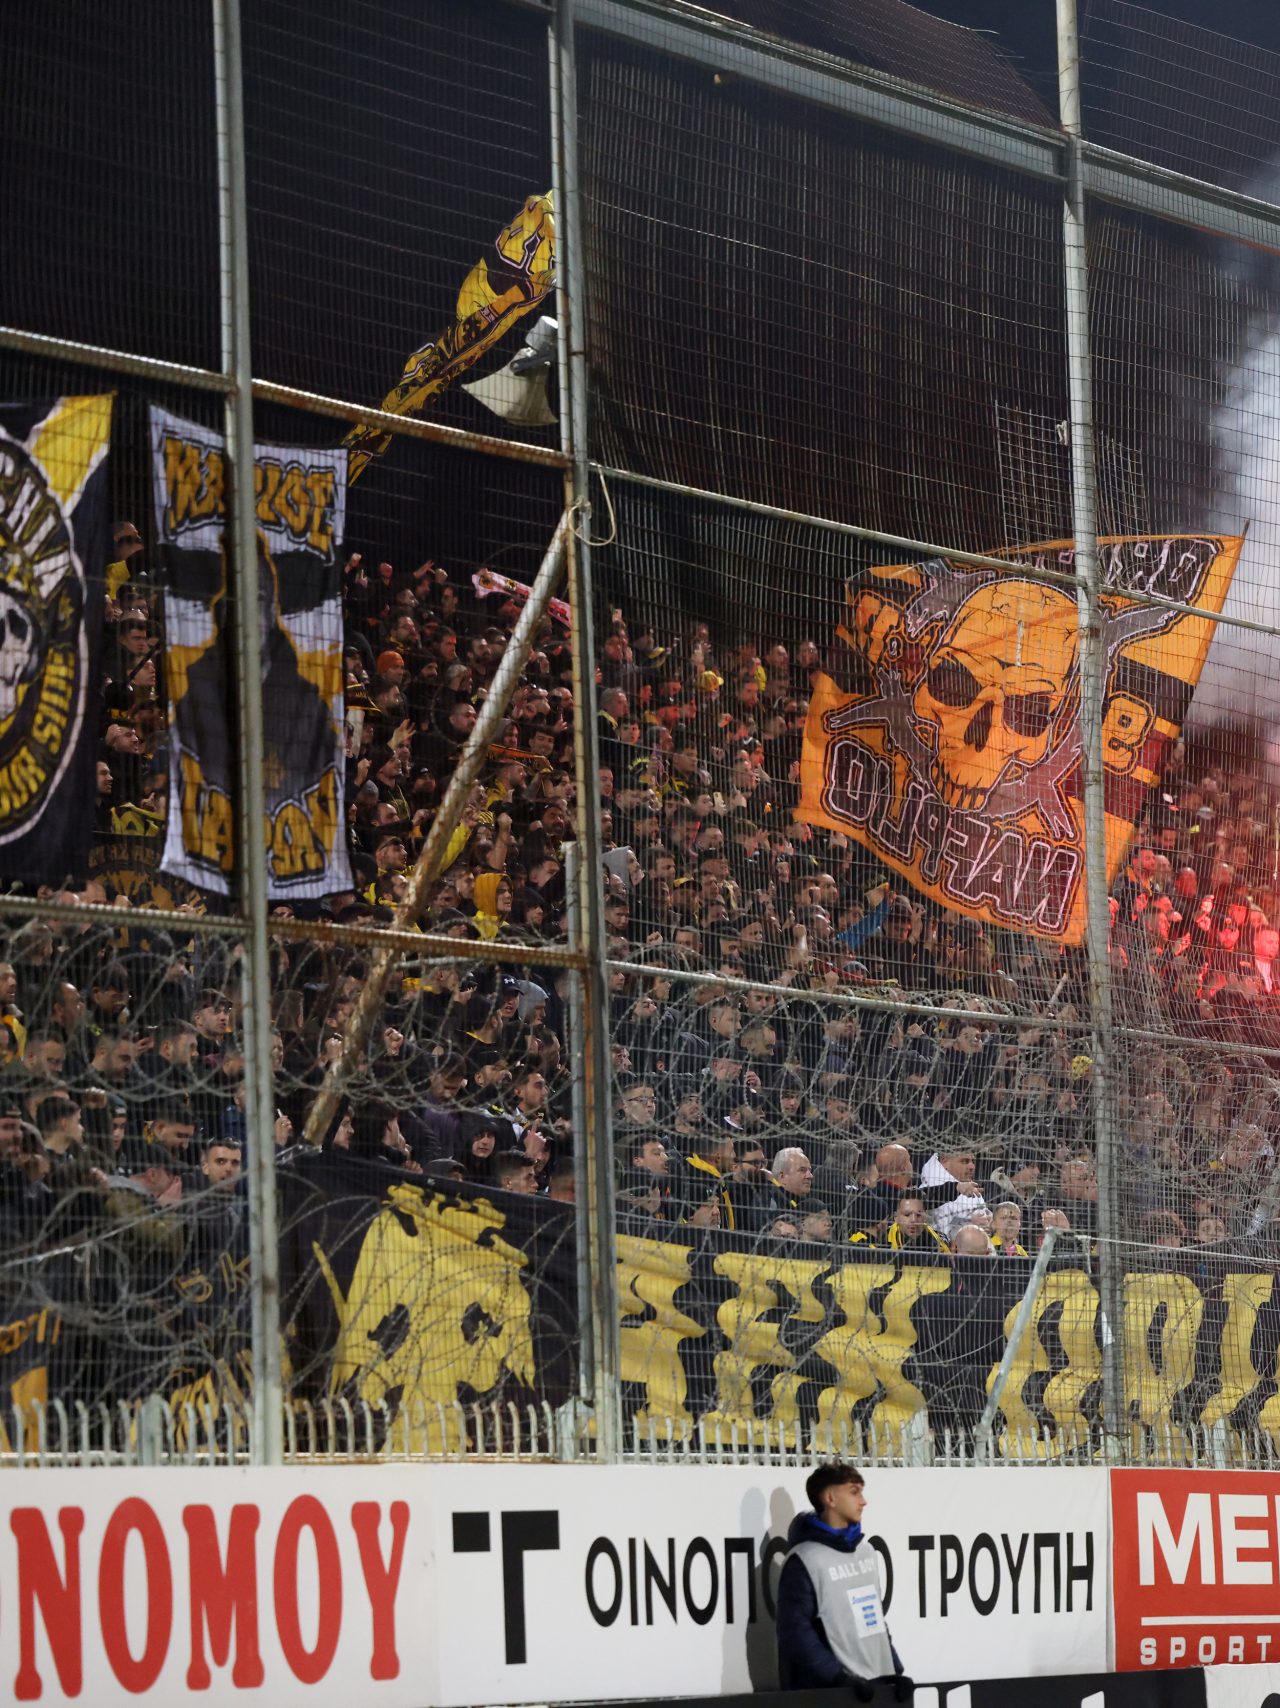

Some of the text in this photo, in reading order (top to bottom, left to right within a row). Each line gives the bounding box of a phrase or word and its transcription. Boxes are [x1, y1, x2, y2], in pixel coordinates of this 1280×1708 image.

[11, 1495, 410, 1700] ΝΟΜΟΥ
[829, 1561, 859, 1581] BALL
[909, 1531, 1094, 1618] ΤΡΟΥΠΗ
